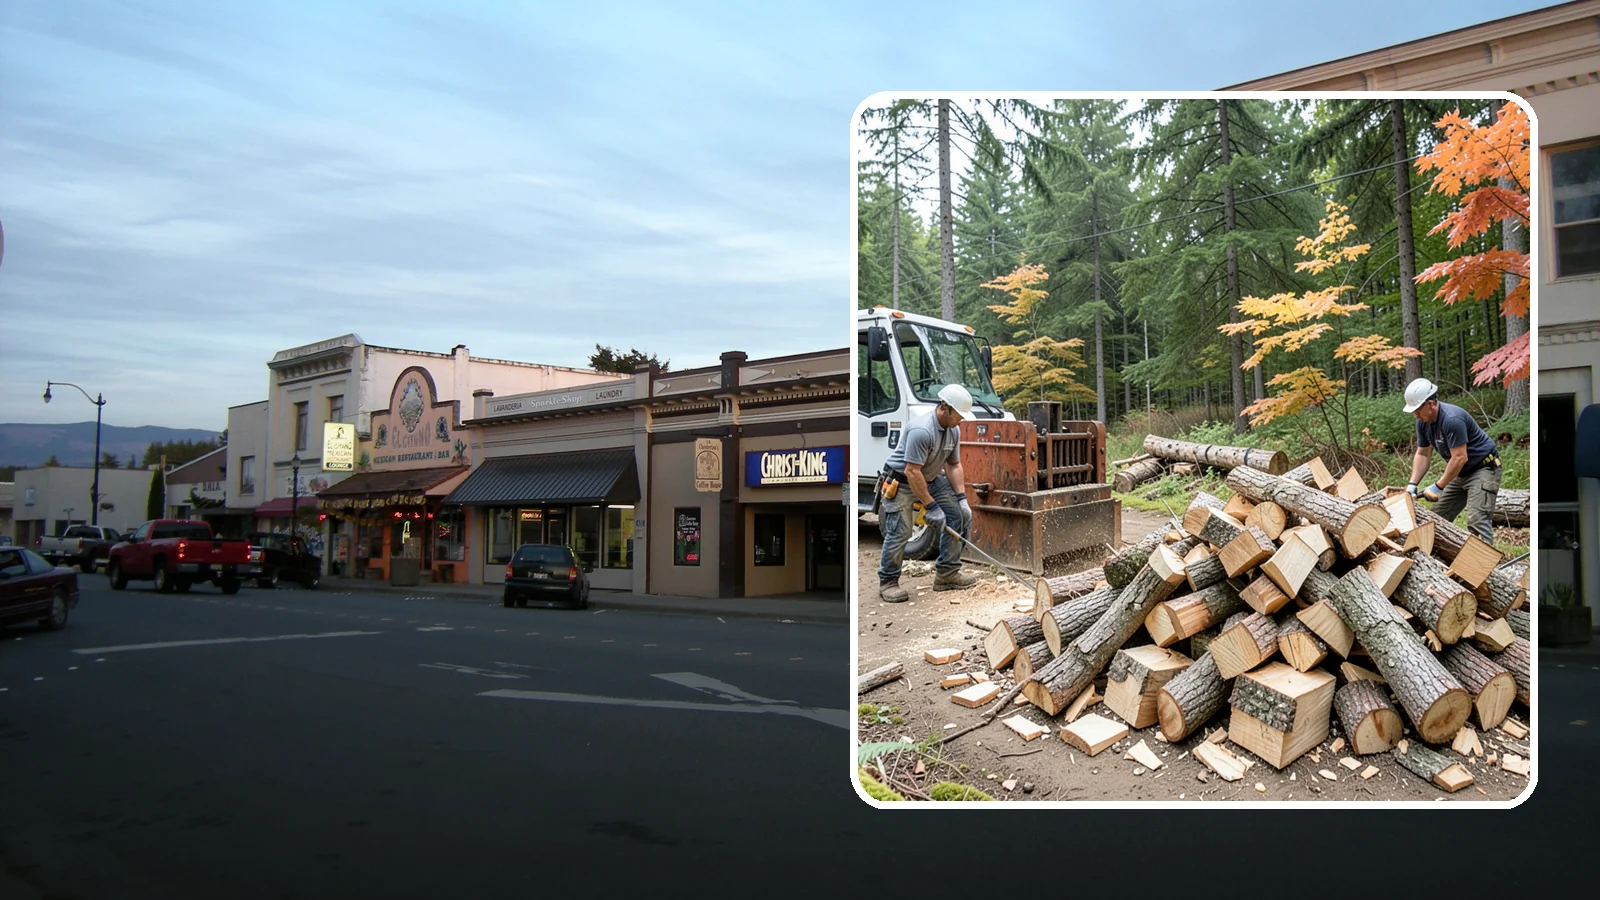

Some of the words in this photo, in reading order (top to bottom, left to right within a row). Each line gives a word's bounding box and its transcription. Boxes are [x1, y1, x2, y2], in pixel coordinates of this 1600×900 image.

[561, 394, 582, 406] Shop
[595, 389, 623, 399] LAUNDRY
[493, 402, 522, 412] LAVANDERIA
[373, 455, 396, 464] MEXICAN
[397, 452, 433, 462] RESTAURANT
[437, 450, 450, 459] BAR
[761, 452, 797, 478] CHRIST
[799, 450, 827, 476] KING
